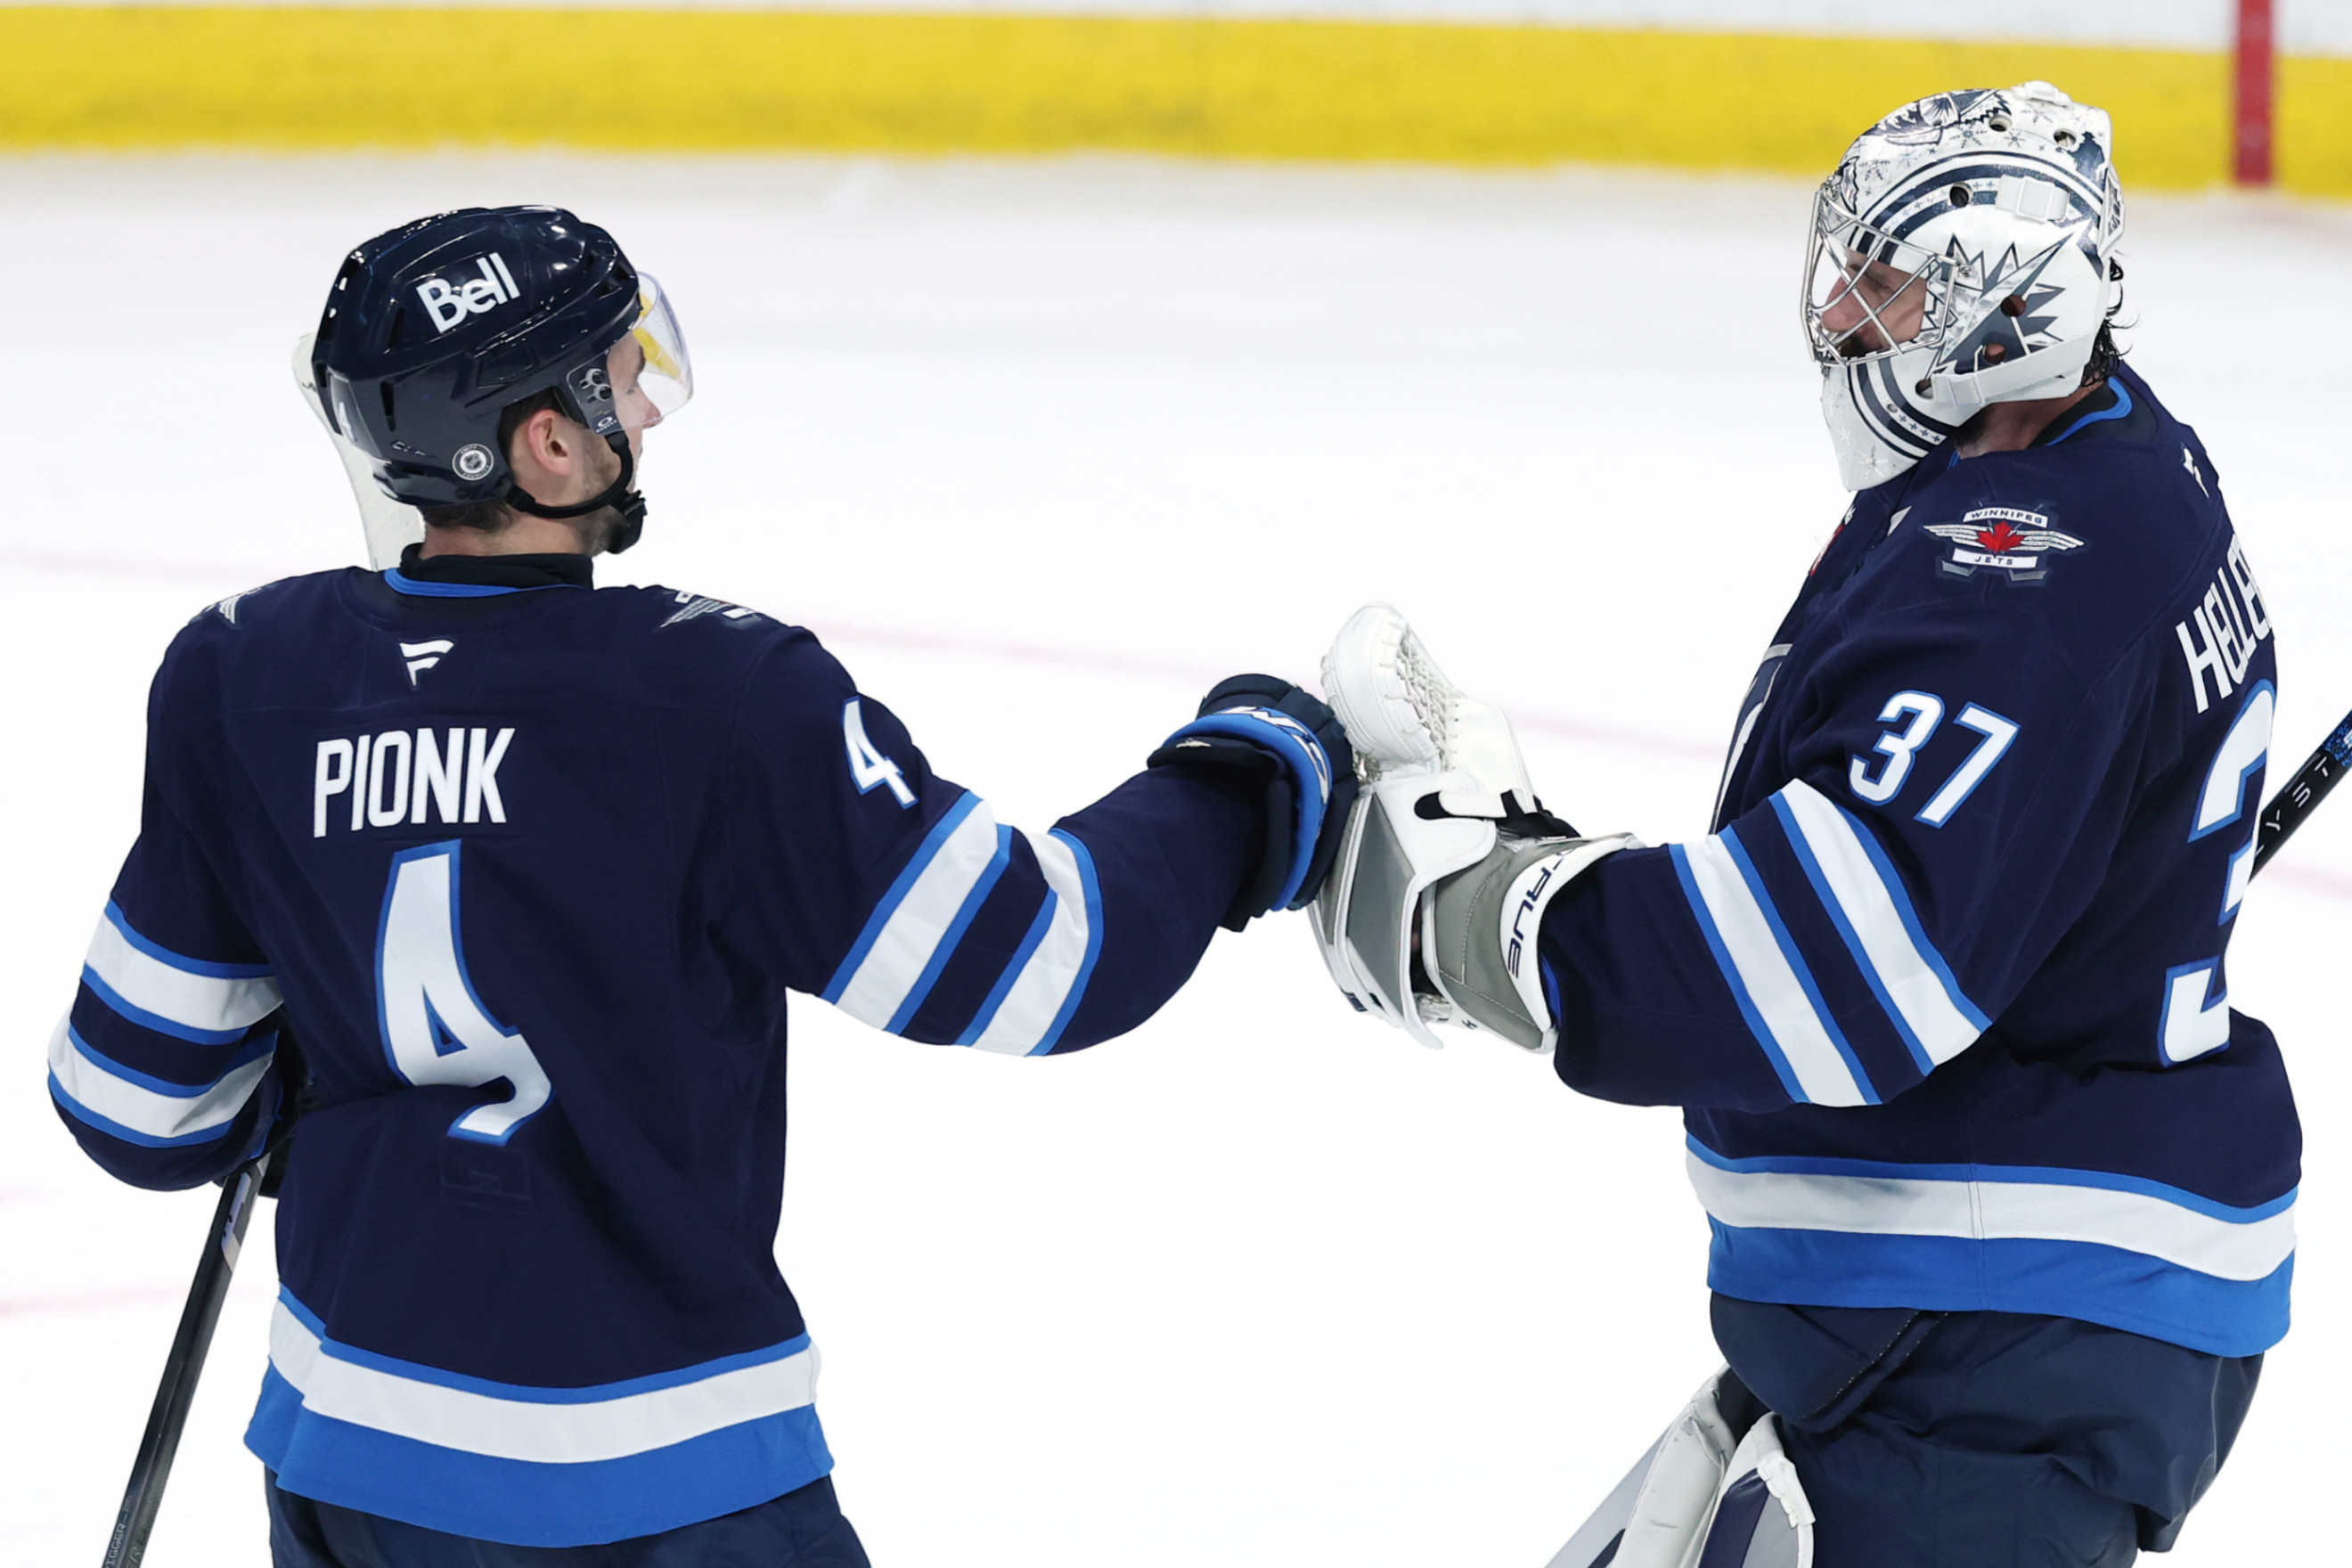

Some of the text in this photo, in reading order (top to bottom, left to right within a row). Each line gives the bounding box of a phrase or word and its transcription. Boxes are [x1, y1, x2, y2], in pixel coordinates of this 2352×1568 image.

[415, 251, 521, 334] Bell
[1971, 509, 2044, 526] WINNIPEG
[1974, 555, 2014, 567] JETS
[313, 727, 517, 838] PIONK
[840, 695, 919, 810] 4
[1848, 690, 2022, 829] 37
[374, 838, 557, 1147] 4
